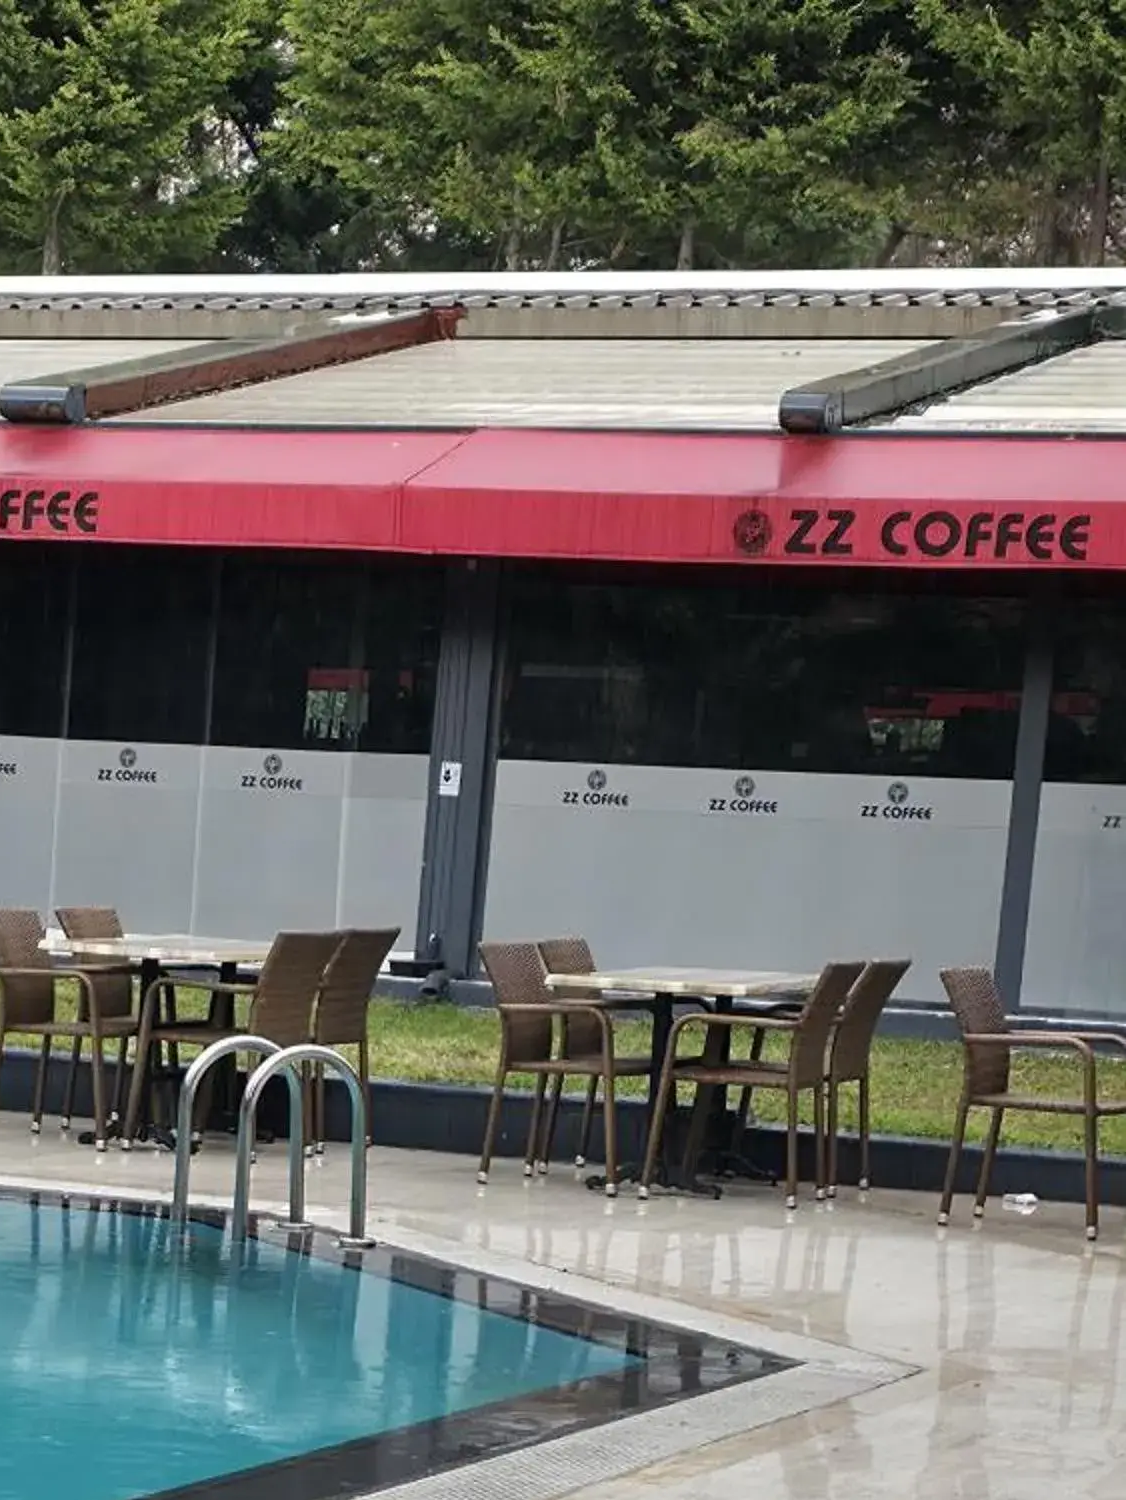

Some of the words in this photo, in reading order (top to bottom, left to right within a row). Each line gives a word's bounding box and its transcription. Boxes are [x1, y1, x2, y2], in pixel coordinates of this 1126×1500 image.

[783, 509, 856, 555] ZZ
[881, 511, 1092, 561] COFFEE
[97, 768, 113, 781] ZZ
[116, 769, 157, 783] COFFEE
[241, 775, 257, 788] ZZ
[260, 776, 303, 791] COFFEE
[562, 791, 579, 804] ZZ
[583, 792, 629, 807] COFFEE
[709, 798, 727, 811] ZZ
[730, 799, 778, 814] COFFEE
[861, 805, 879, 818] ZZ
[882, 805, 932, 820] COFFEE
[1102, 815, 1121, 829] ZZ
